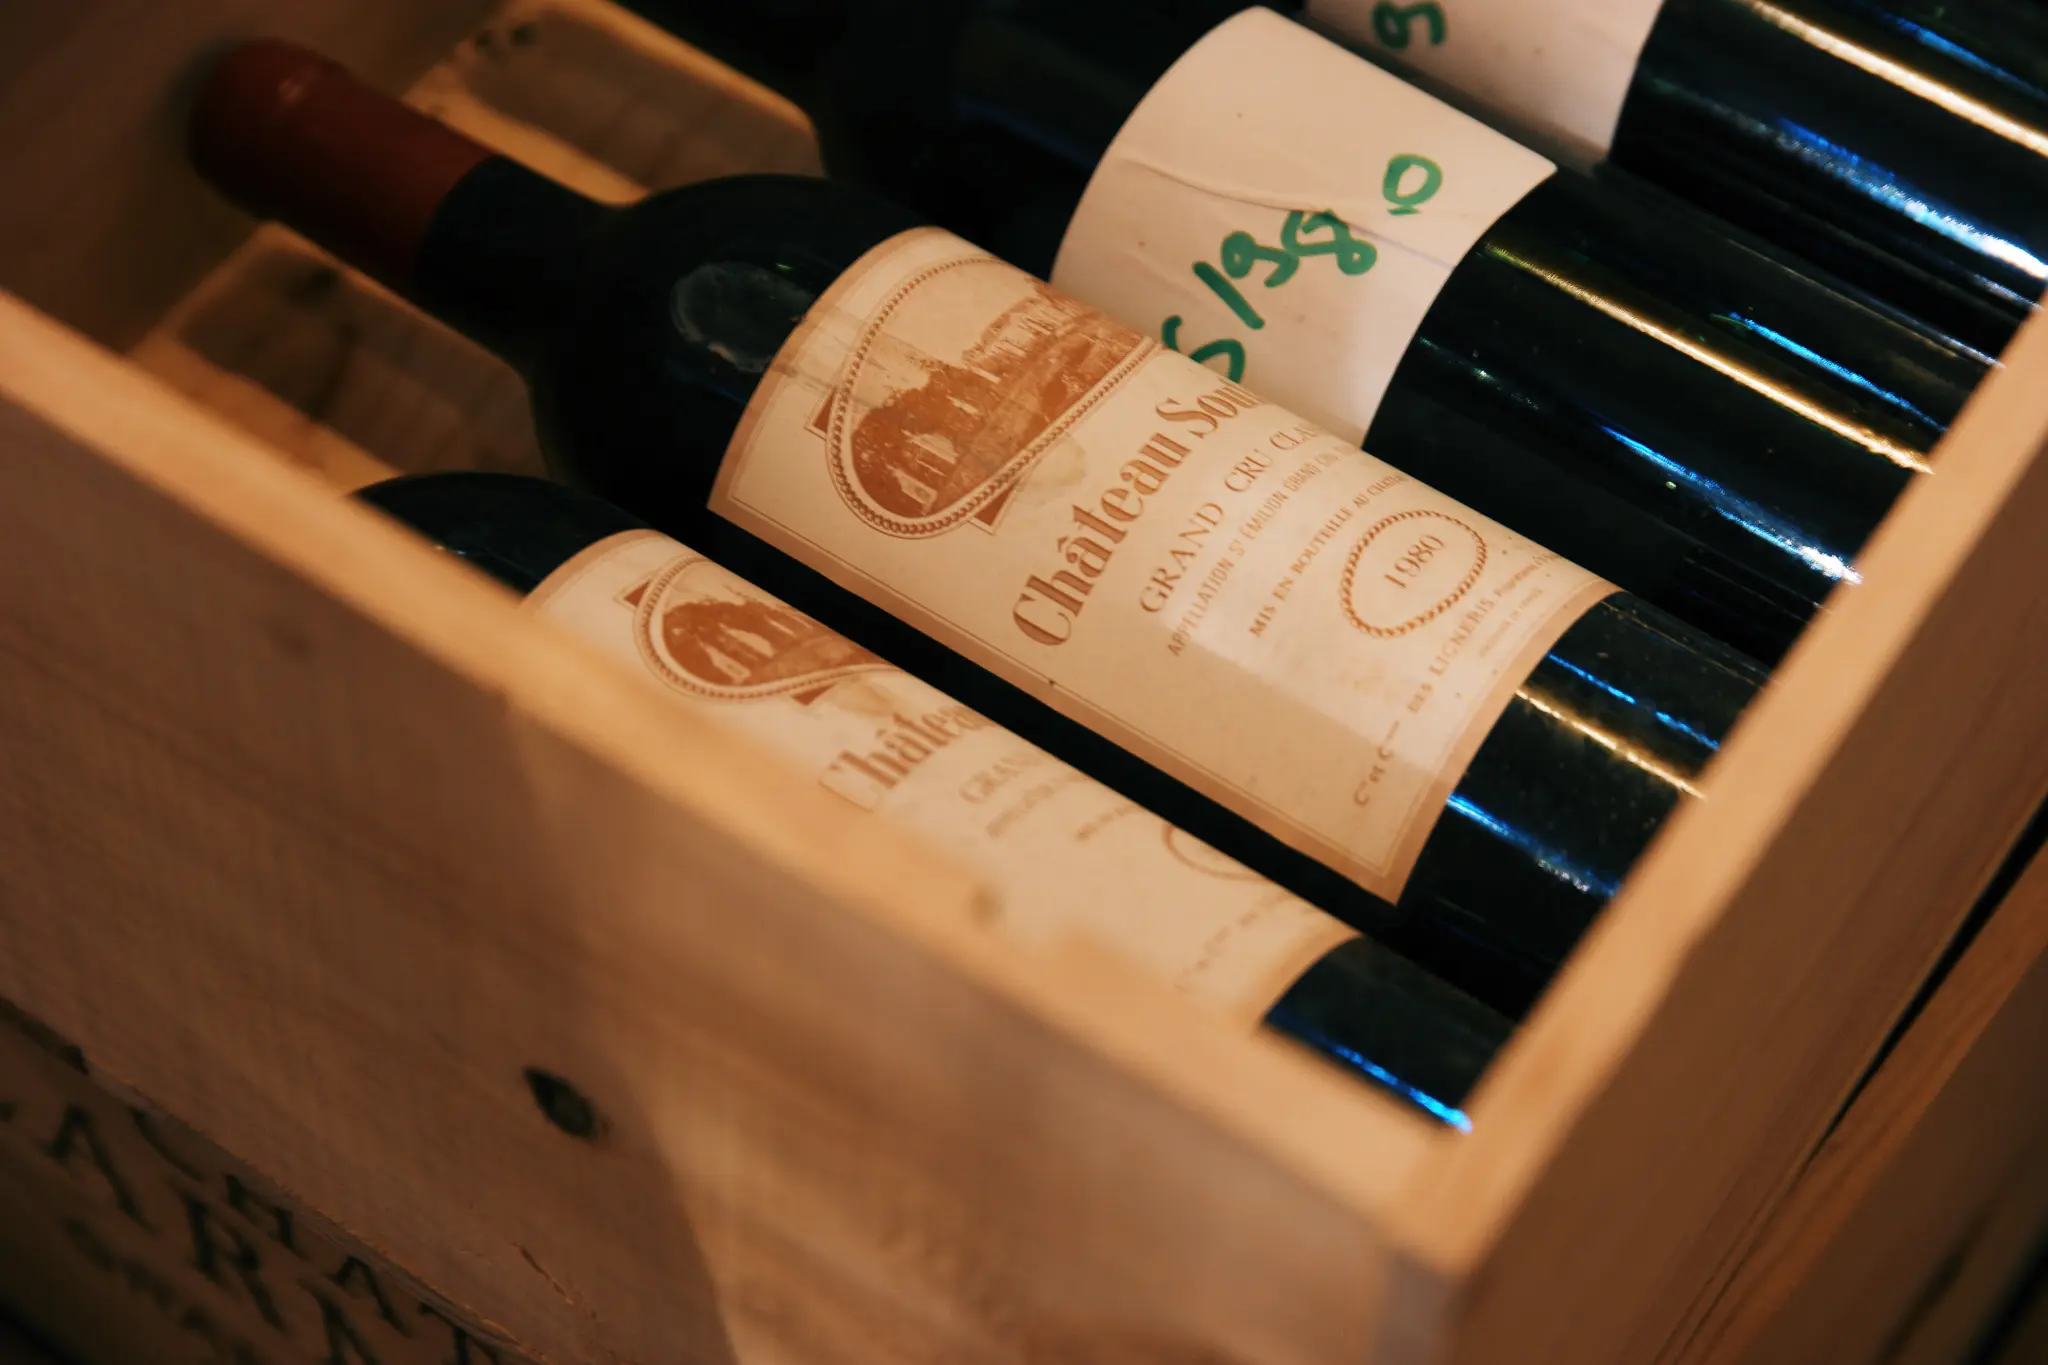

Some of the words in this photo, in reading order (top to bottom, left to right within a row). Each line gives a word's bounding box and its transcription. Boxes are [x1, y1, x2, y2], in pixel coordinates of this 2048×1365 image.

[1011, 431, 1192, 647] Château
[1154, 375, 1268, 439] Sou
[1139, 502, 1225, 614] GRAND
[1223, 447, 1273, 493] CRU
[1249, 603, 1277, 638] MIS
[1272, 576, 1294, 602] EN
[1290, 506, 1355, 576] BOUTEILLE
[1384, 534, 1445, 589] 1980
[1167, 557, 1235, 657] APPELLATION
[817, 702, 998, 814] Châtea
